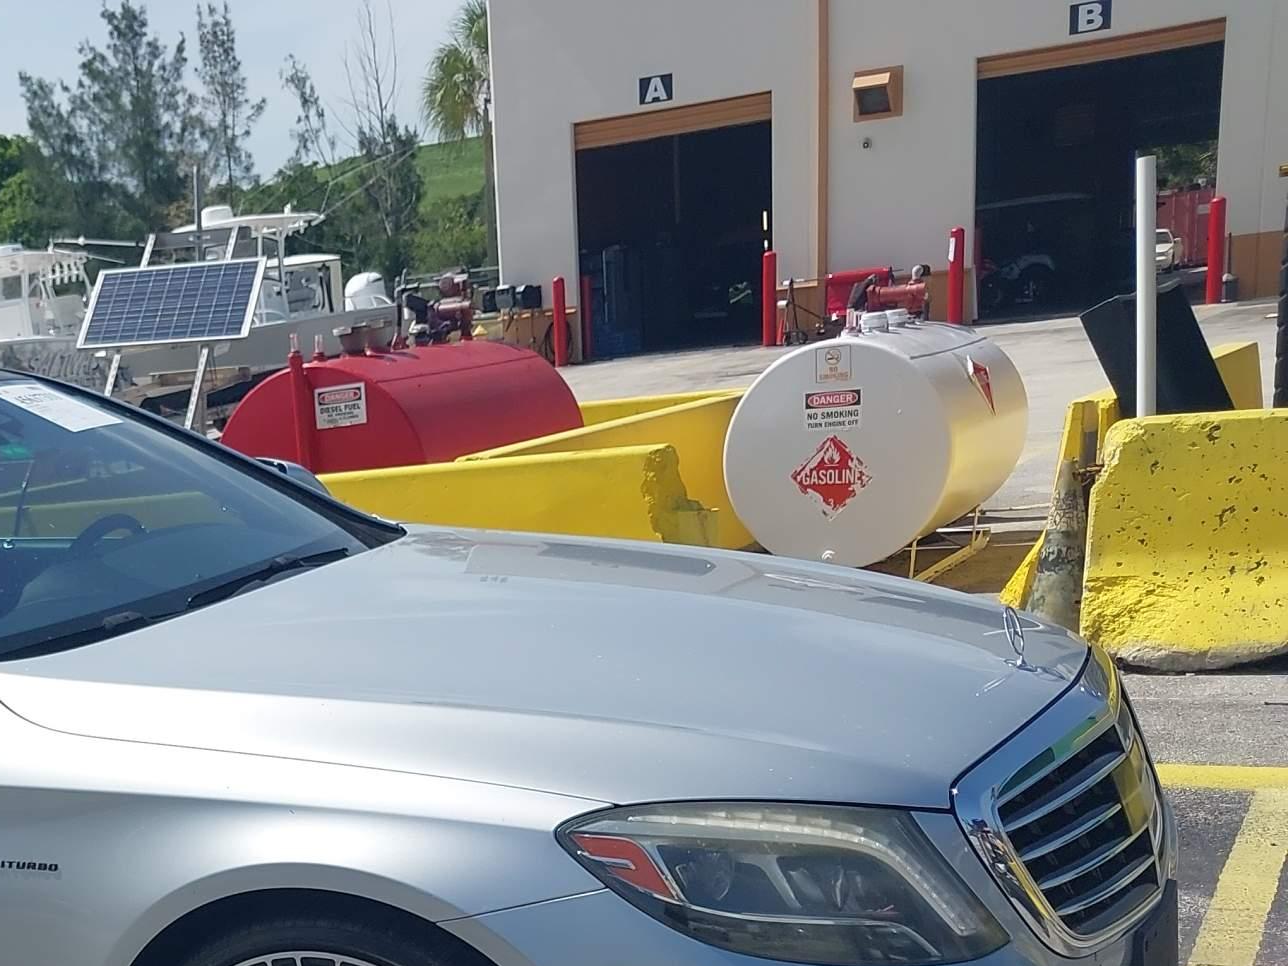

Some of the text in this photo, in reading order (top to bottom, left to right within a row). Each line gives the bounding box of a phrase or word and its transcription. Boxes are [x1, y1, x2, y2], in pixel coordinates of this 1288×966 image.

[1078, 3, 1103, 32] B
[645, 77, 668, 102] A
[813, 394, 853, 405] DANGER
[344, 402, 360, 411] FUEL
[807, 409, 859, 421] NO SMOKING
[824, 420, 846, 428] ENGINE
[802, 468, 861, 485] GASOLINE
